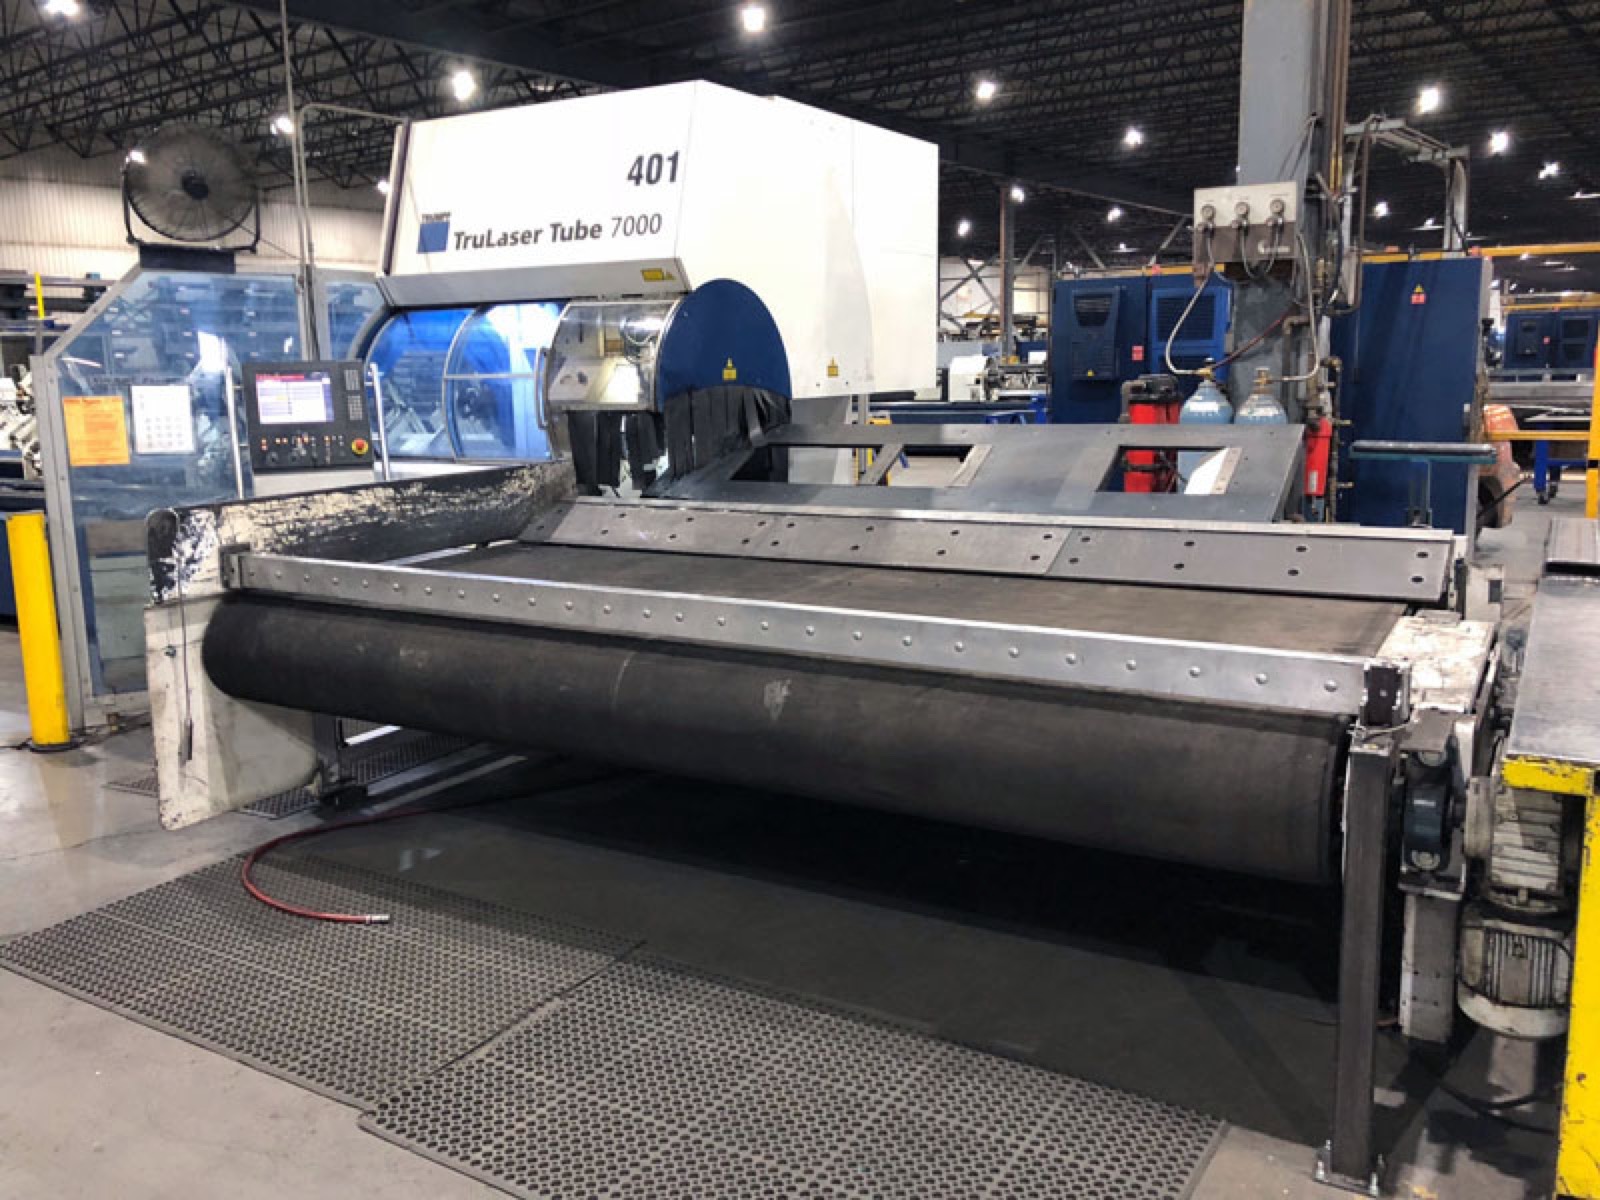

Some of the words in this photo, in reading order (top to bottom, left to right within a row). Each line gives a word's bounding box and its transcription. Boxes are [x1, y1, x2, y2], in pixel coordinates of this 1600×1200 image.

[626, 150, 679, 187] 401
[454, 228, 544, 250] TruLaser
[550, 219, 603, 243] Tube
[611, 213, 663, 238] 7000
